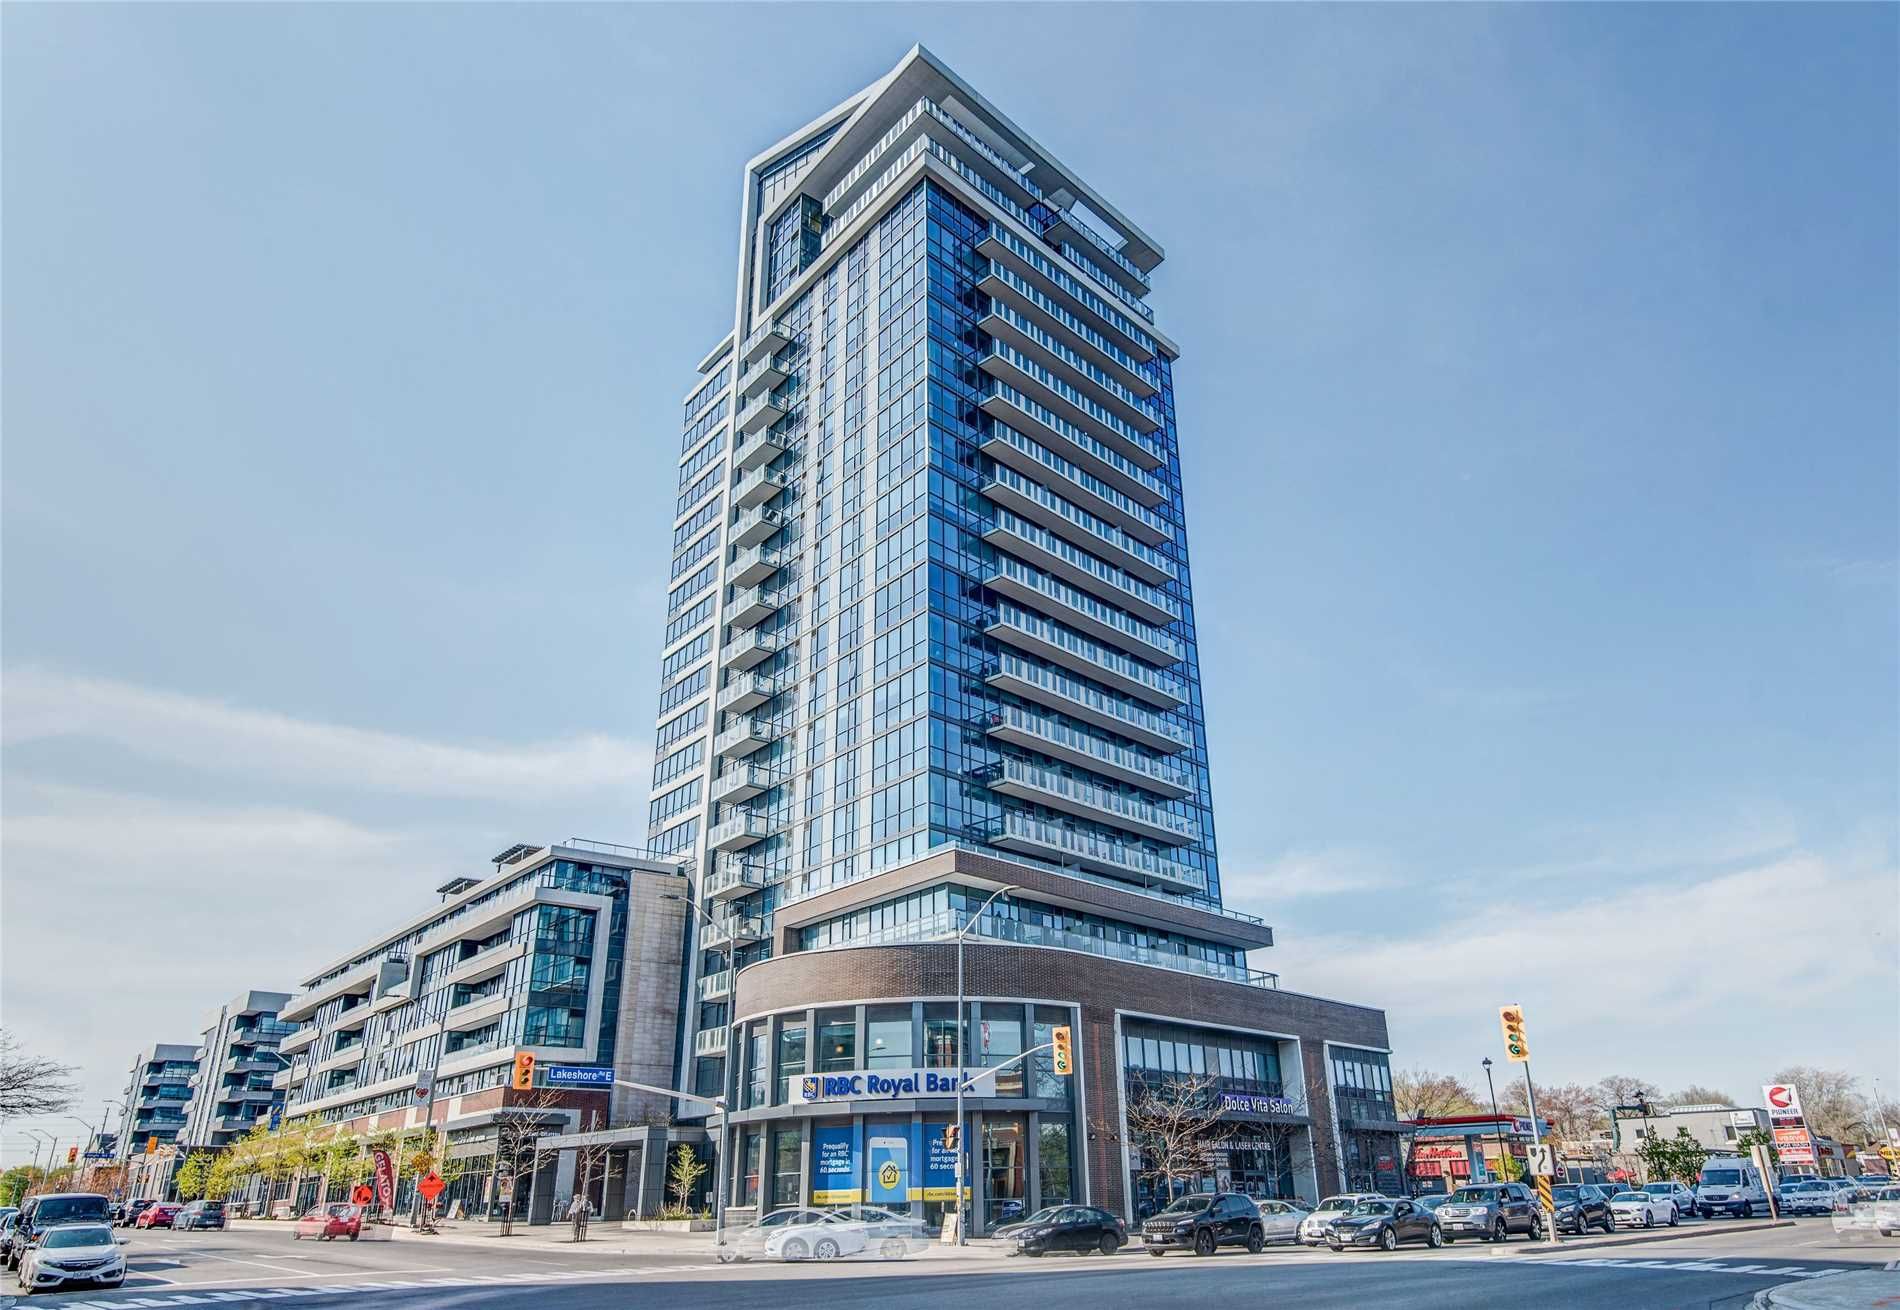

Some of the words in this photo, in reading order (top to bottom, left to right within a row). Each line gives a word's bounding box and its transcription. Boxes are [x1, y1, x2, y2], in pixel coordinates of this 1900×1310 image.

[550, 1068, 597, 1080] Lakeshore
[605, 1071, 612, 1081] E
[825, 1075, 862, 1096] RBC
[867, 1071, 920, 1097] Royal
[1225, 1096, 1249, 1111] Dolce
[1251, 1098, 1268, 1112] Vita
[1269, 1099, 1294, 1114] Salon
[822, 1142, 849, 1151] Prequalify
[1235, 1141, 1251, 1150] LASER
[1252, 1142, 1271, 1151] CENTRE
[820, 1159, 845, 1167] mortgage
[375, 1152, 391, 1197] GELATO
